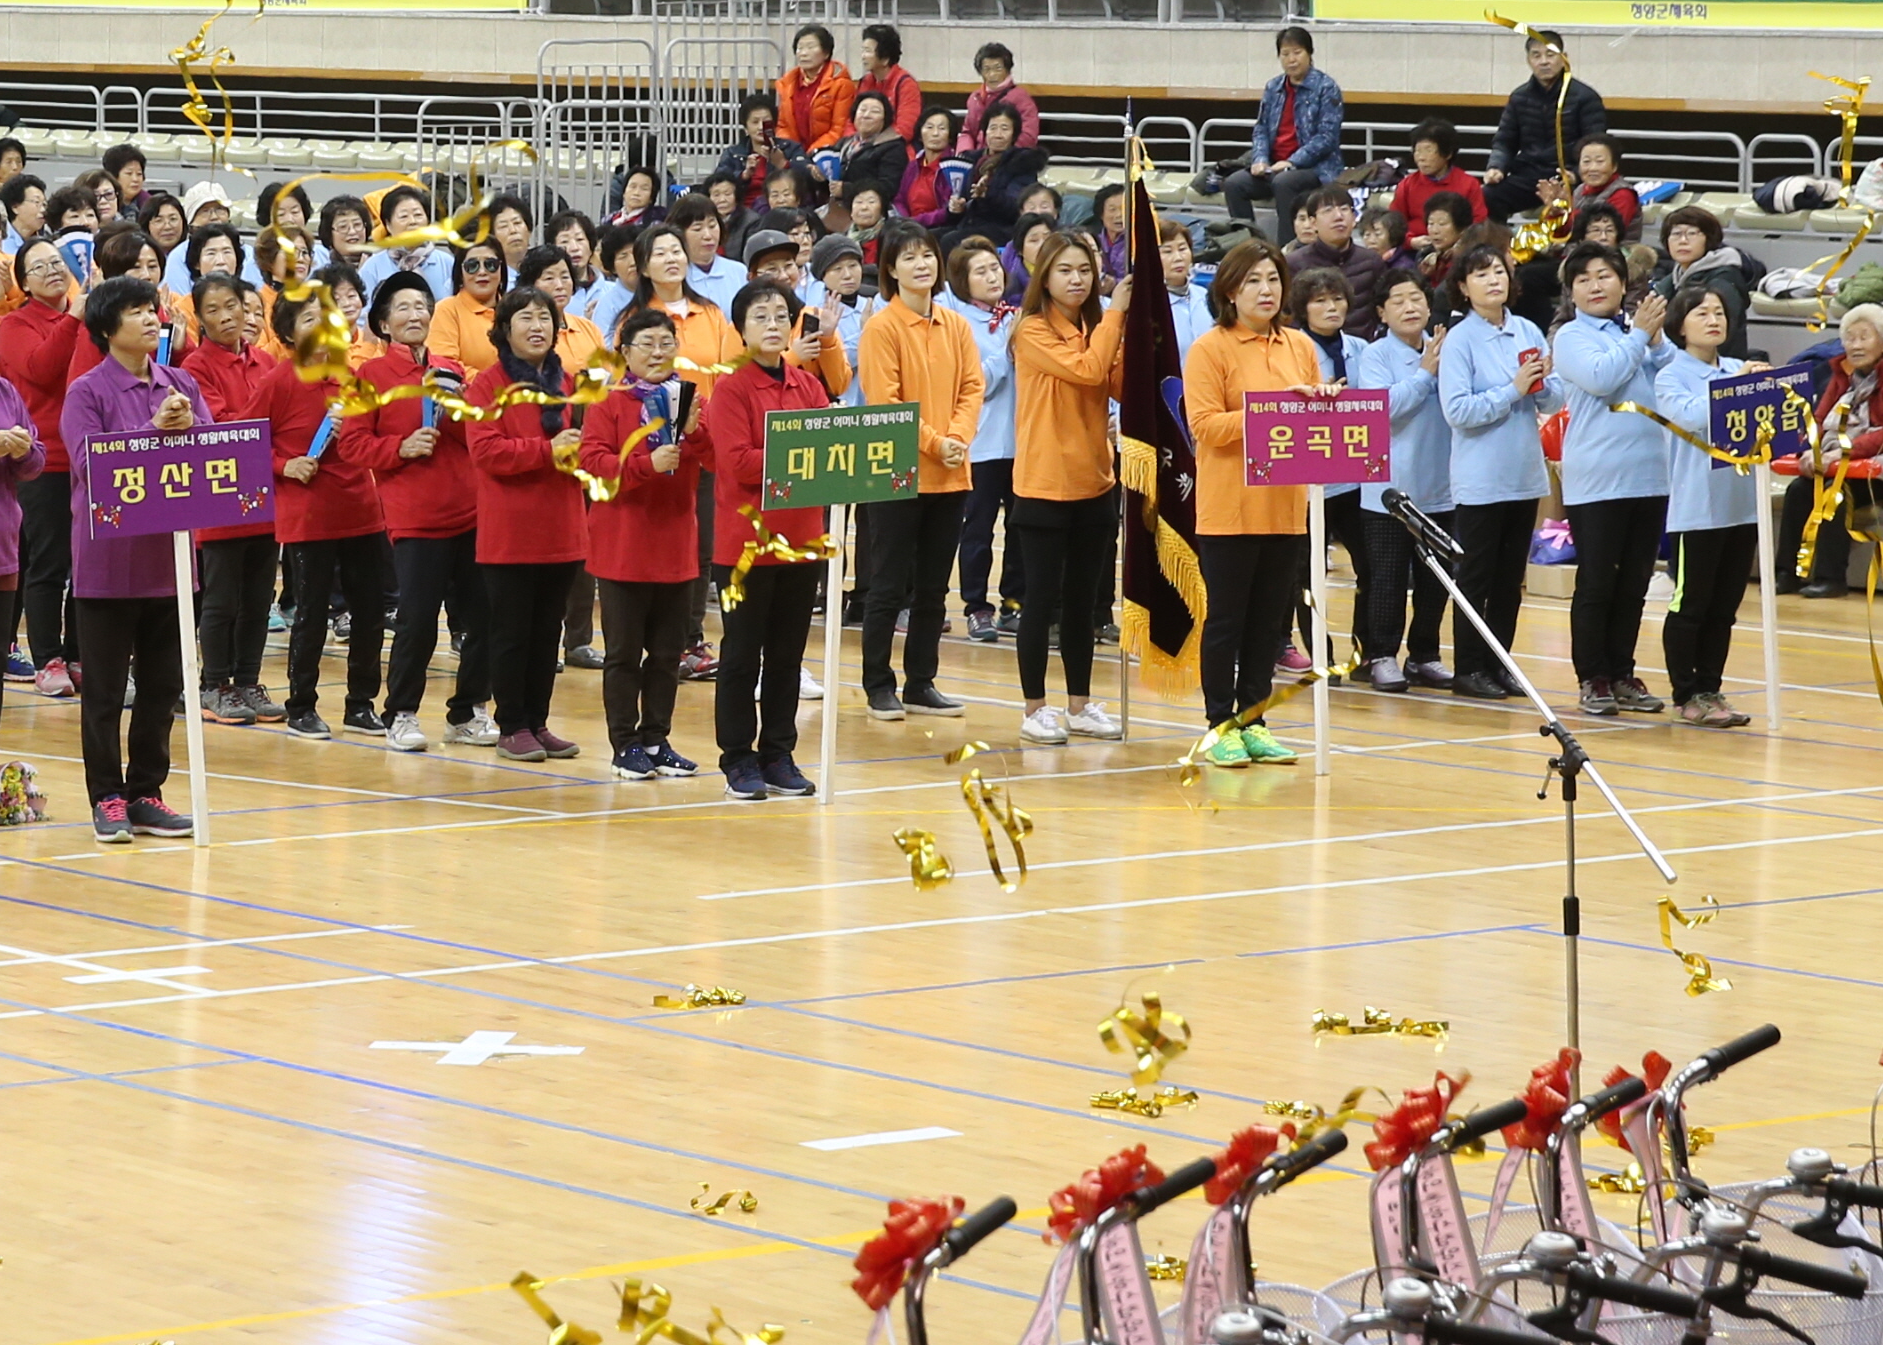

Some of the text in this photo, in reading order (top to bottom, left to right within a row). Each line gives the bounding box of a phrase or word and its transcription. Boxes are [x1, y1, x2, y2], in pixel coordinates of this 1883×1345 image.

[1630, 2, 1708, 20] 청양군체육회
[1249, 402, 1278, 414] 제14회
[1280, 401, 1306, 414] 청양군
[1307, 401, 1333, 413] 어머니
[771, 410, 914, 432] 제14회 청양군 어머니 생활체육대회
[91, 428, 260, 455] 제14회 청양군 어머니 생활체육대회
